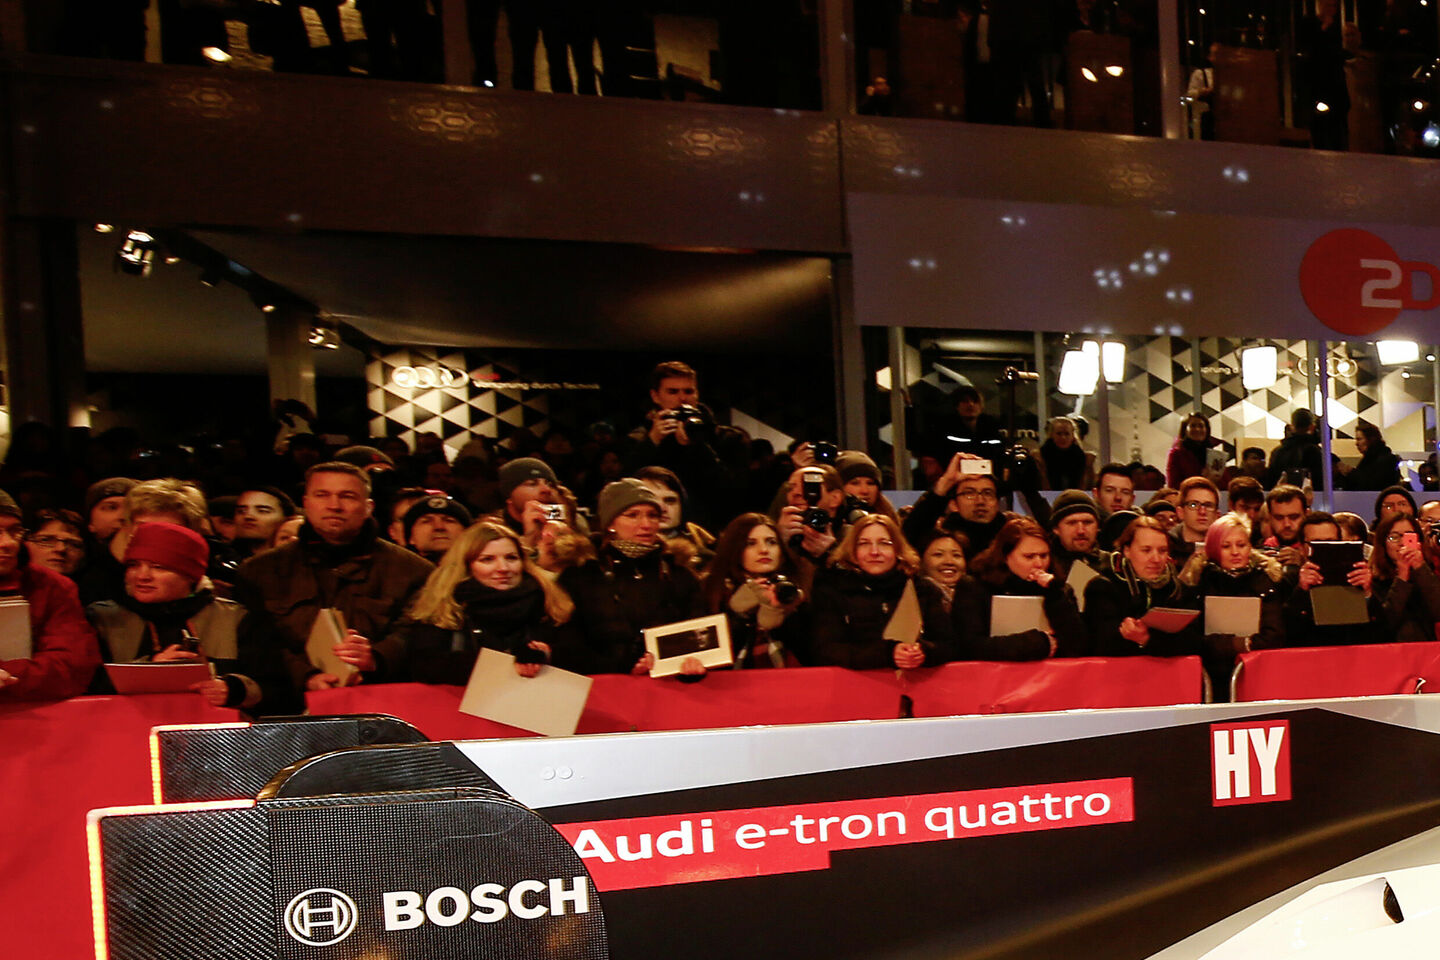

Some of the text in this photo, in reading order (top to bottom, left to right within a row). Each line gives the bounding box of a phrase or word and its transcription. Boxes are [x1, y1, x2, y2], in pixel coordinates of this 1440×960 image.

[1213, 727, 1287, 799] HY
[573, 791, 1111, 863] Audi e-tron quattro
[382, 876, 591, 932] BOSCH
